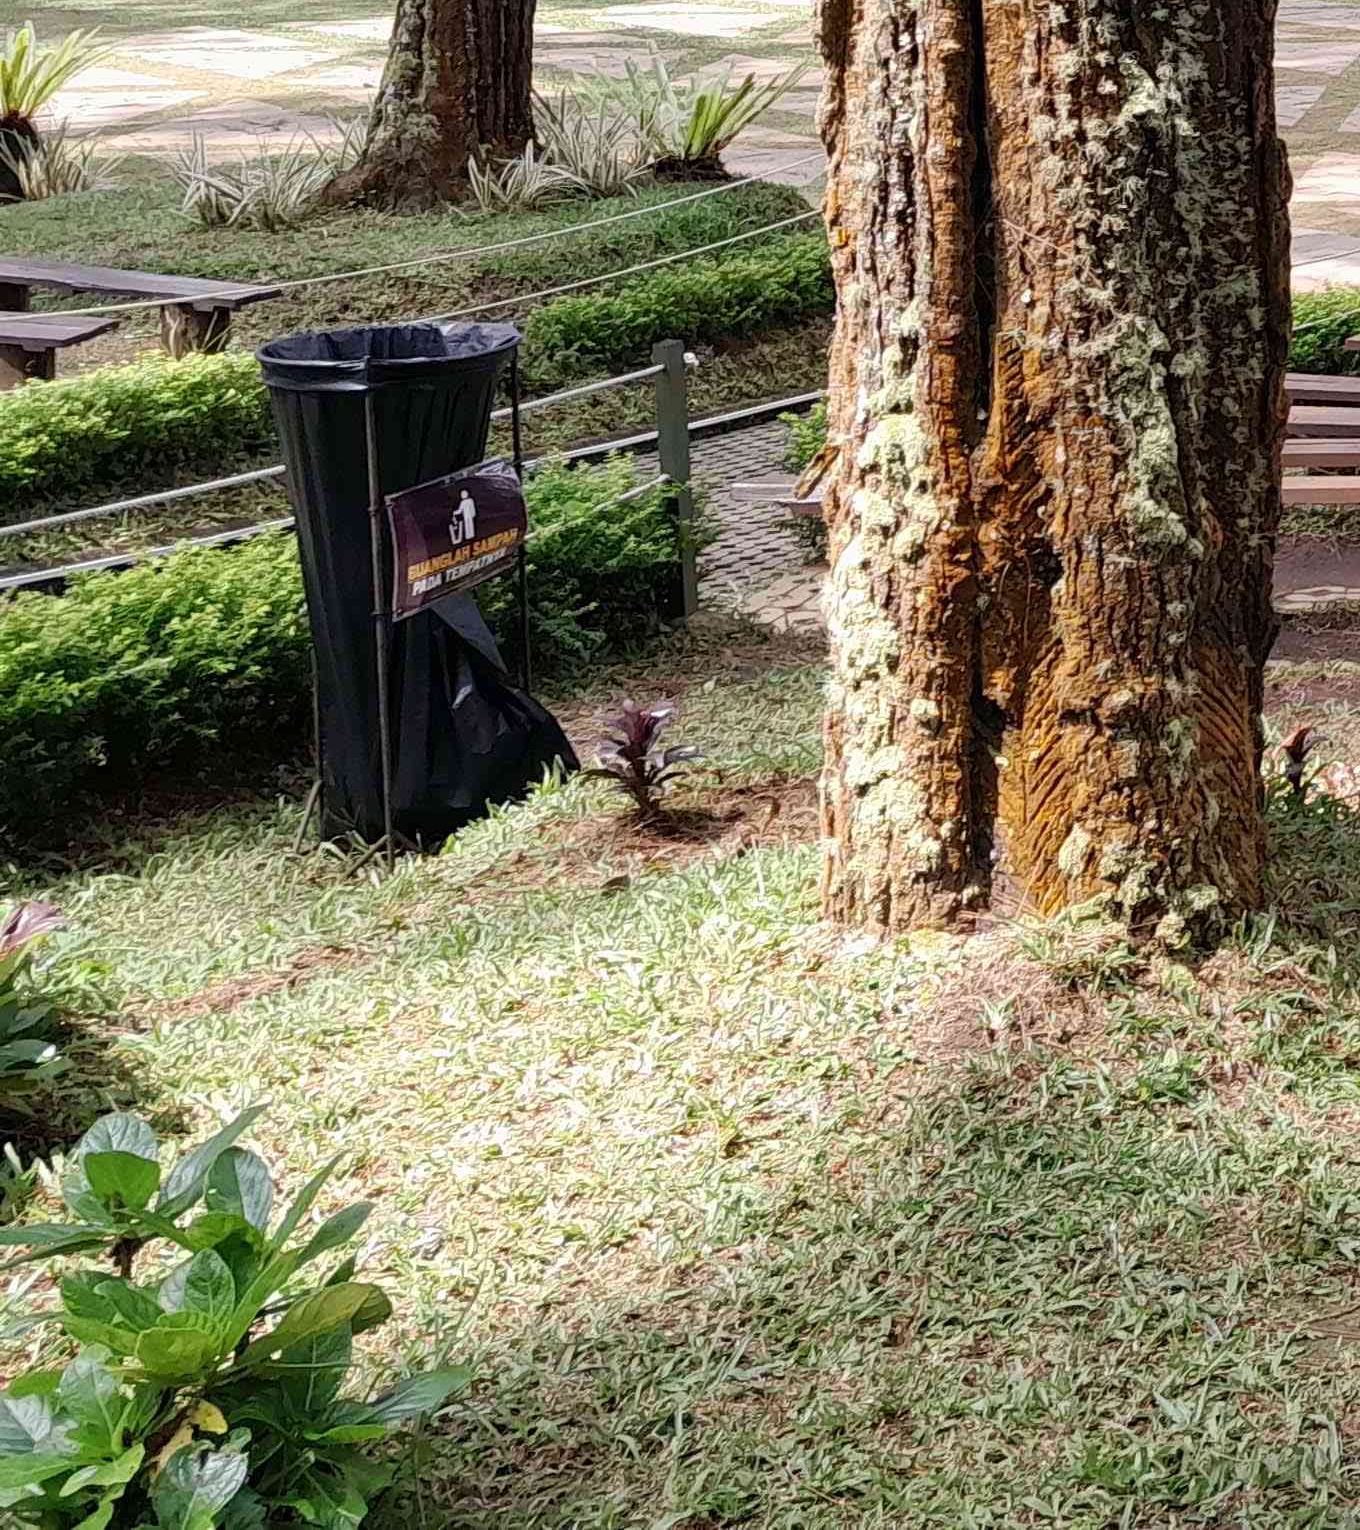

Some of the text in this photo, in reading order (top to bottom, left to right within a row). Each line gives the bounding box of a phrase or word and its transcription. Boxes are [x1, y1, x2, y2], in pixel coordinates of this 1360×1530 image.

[408, 527, 519, 583] BUANGLAH SAMPAH
[412, 572, 442, 596] PADA
